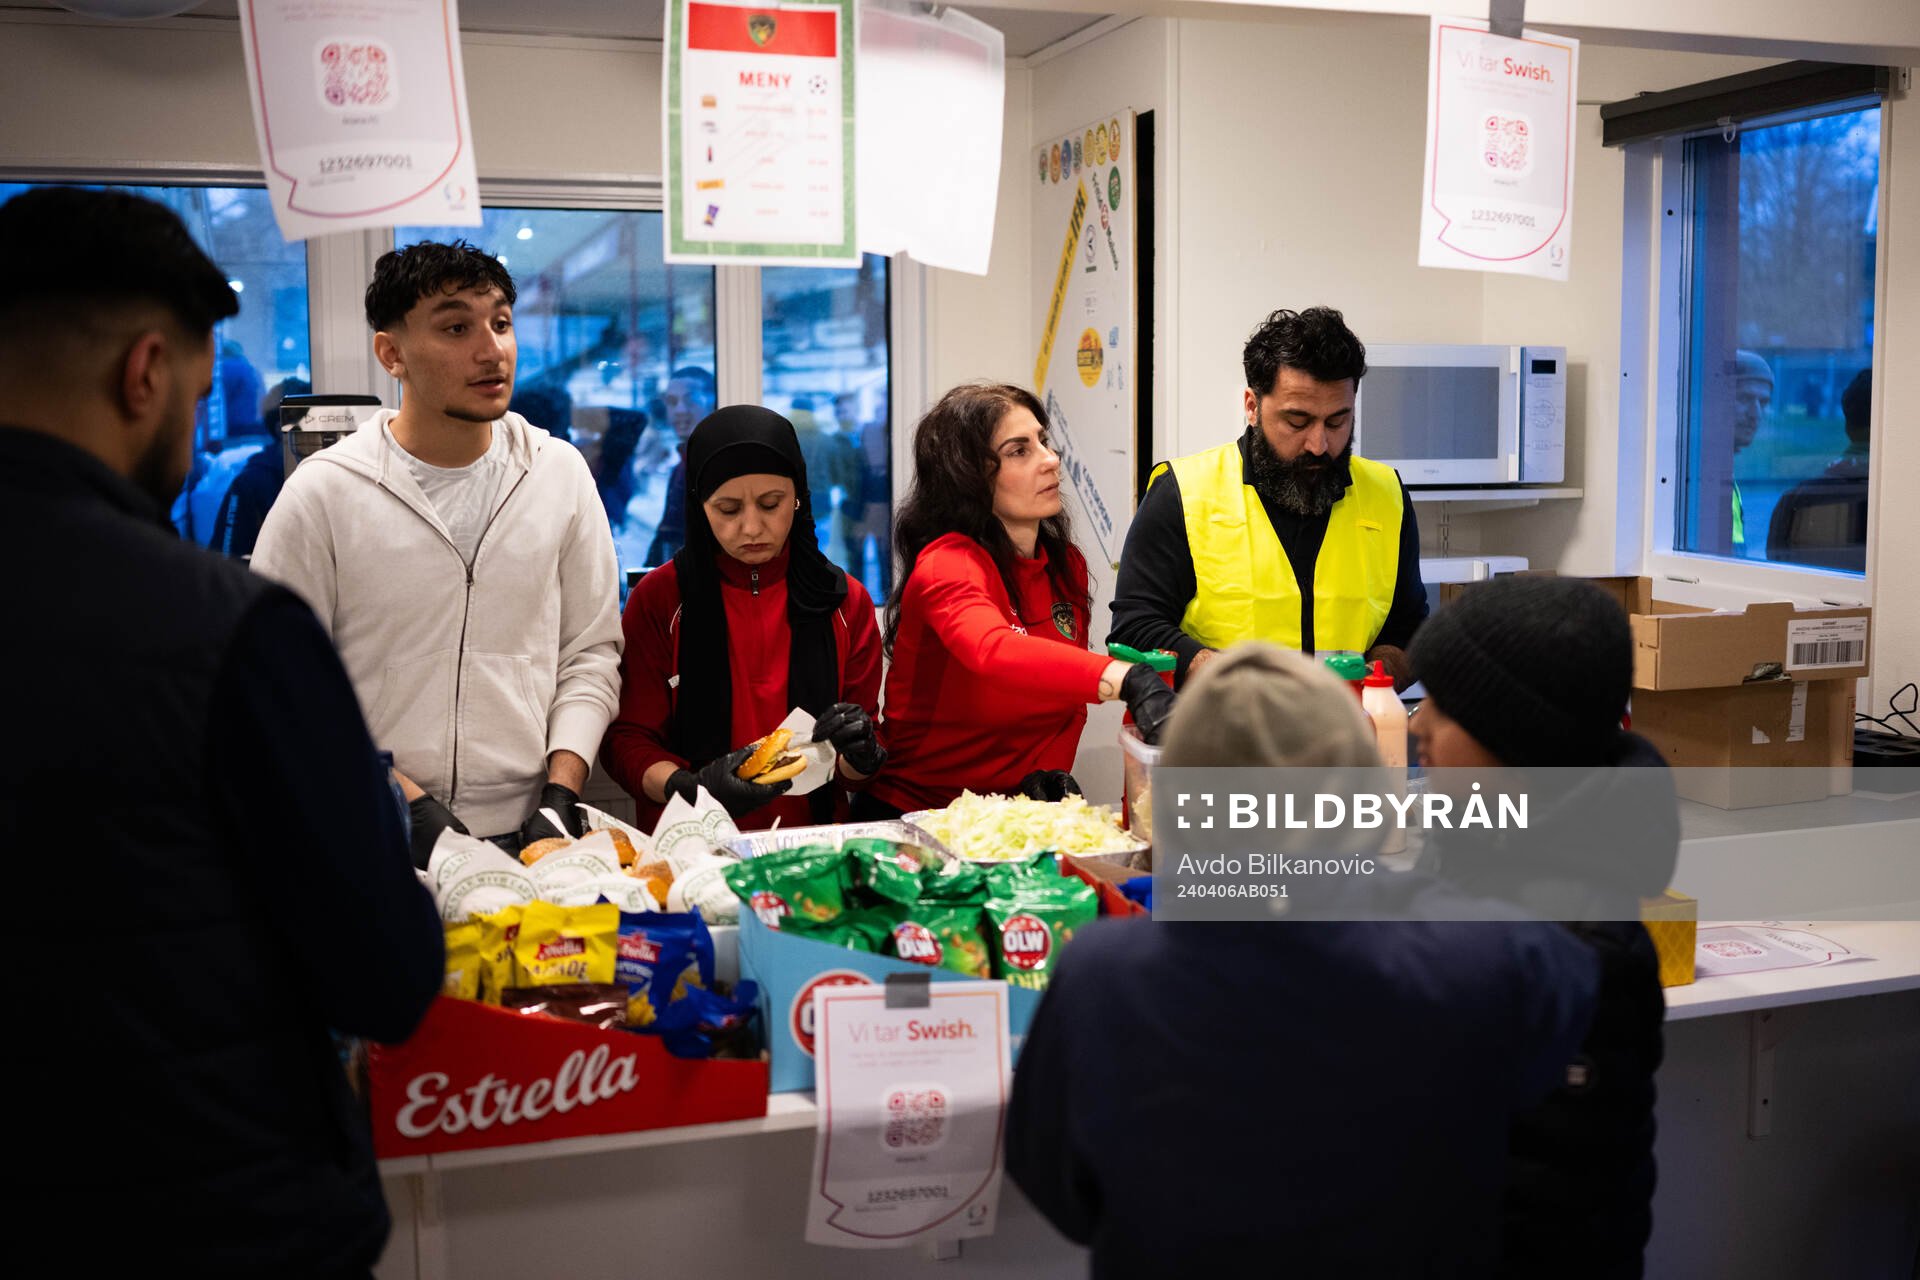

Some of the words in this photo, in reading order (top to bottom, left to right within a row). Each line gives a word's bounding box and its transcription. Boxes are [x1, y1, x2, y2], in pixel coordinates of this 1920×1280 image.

[739, 72, 792, 89] MENY
[1503, 56, 1555, 83] Swish.
[318, 415, 354, 423] CREM
[896, 935, 937, 959] OLW
[1003, 929, 1045, 953] OLW
[848, 1022, 869, 1043] Vi
[874, 1022, 900, 1042] tar
[907, 1018, 978, 1042] Swish.
[395, 1043, 640, 1138] Estrella
